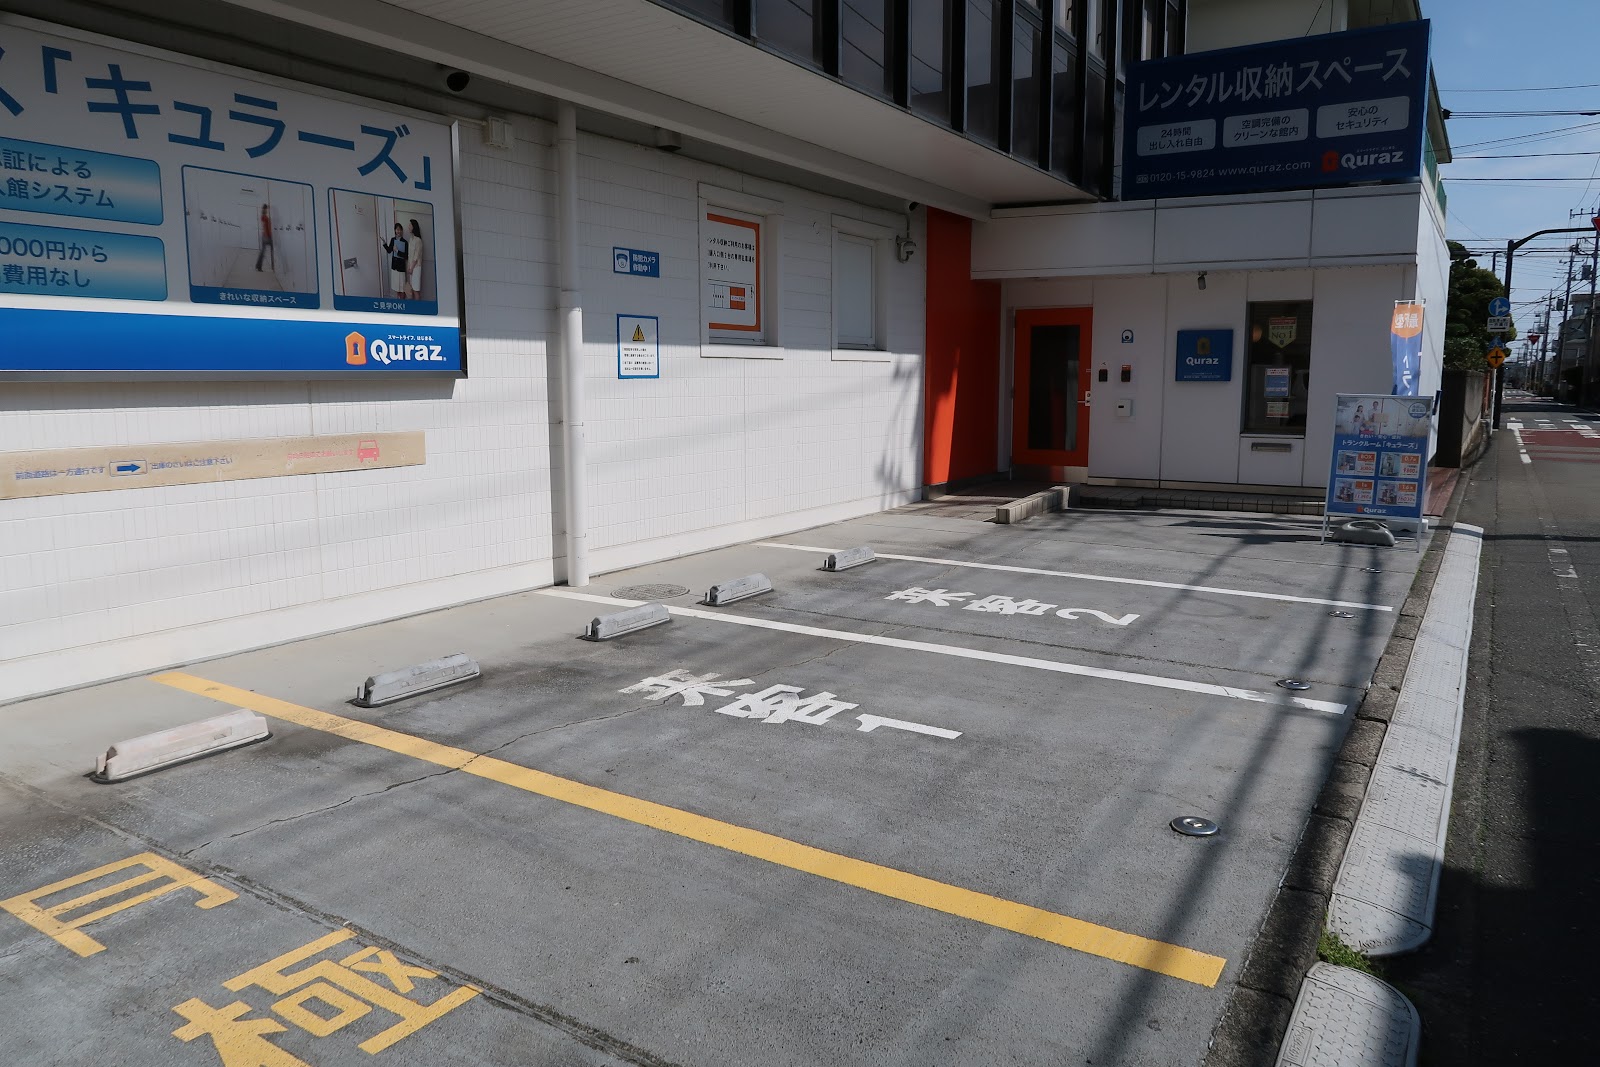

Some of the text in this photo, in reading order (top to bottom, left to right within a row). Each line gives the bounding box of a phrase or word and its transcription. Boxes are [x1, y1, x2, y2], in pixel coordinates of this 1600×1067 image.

[1138, 47, 1411, 113] レンタル収納スペース
[1347, 104, 1379, 118] 安心の
[1241, 115, 1291, 130] 空調完備の
[1335, 116, 1389, 131] セキュリティ
[1160, 126, 1192, 139] 24時間
[1233, 126, 1300, 142] クリーンな館内
[1149, 136, 1203, 151] 出し入れ自由
[0, 149, 92, 180] 証による
[1340, 149, 1404, 170] Quraz
[1150, 159, 1311, 183] 0120-15-9824 www.quraz.com
[219, 291, 297, 304] きれいな収納スペース
[370, 338, 443, 366] Quraz
[1186, 356, 1219, 366] Quraz
[1363, 506, 1387, 514] Quraz
